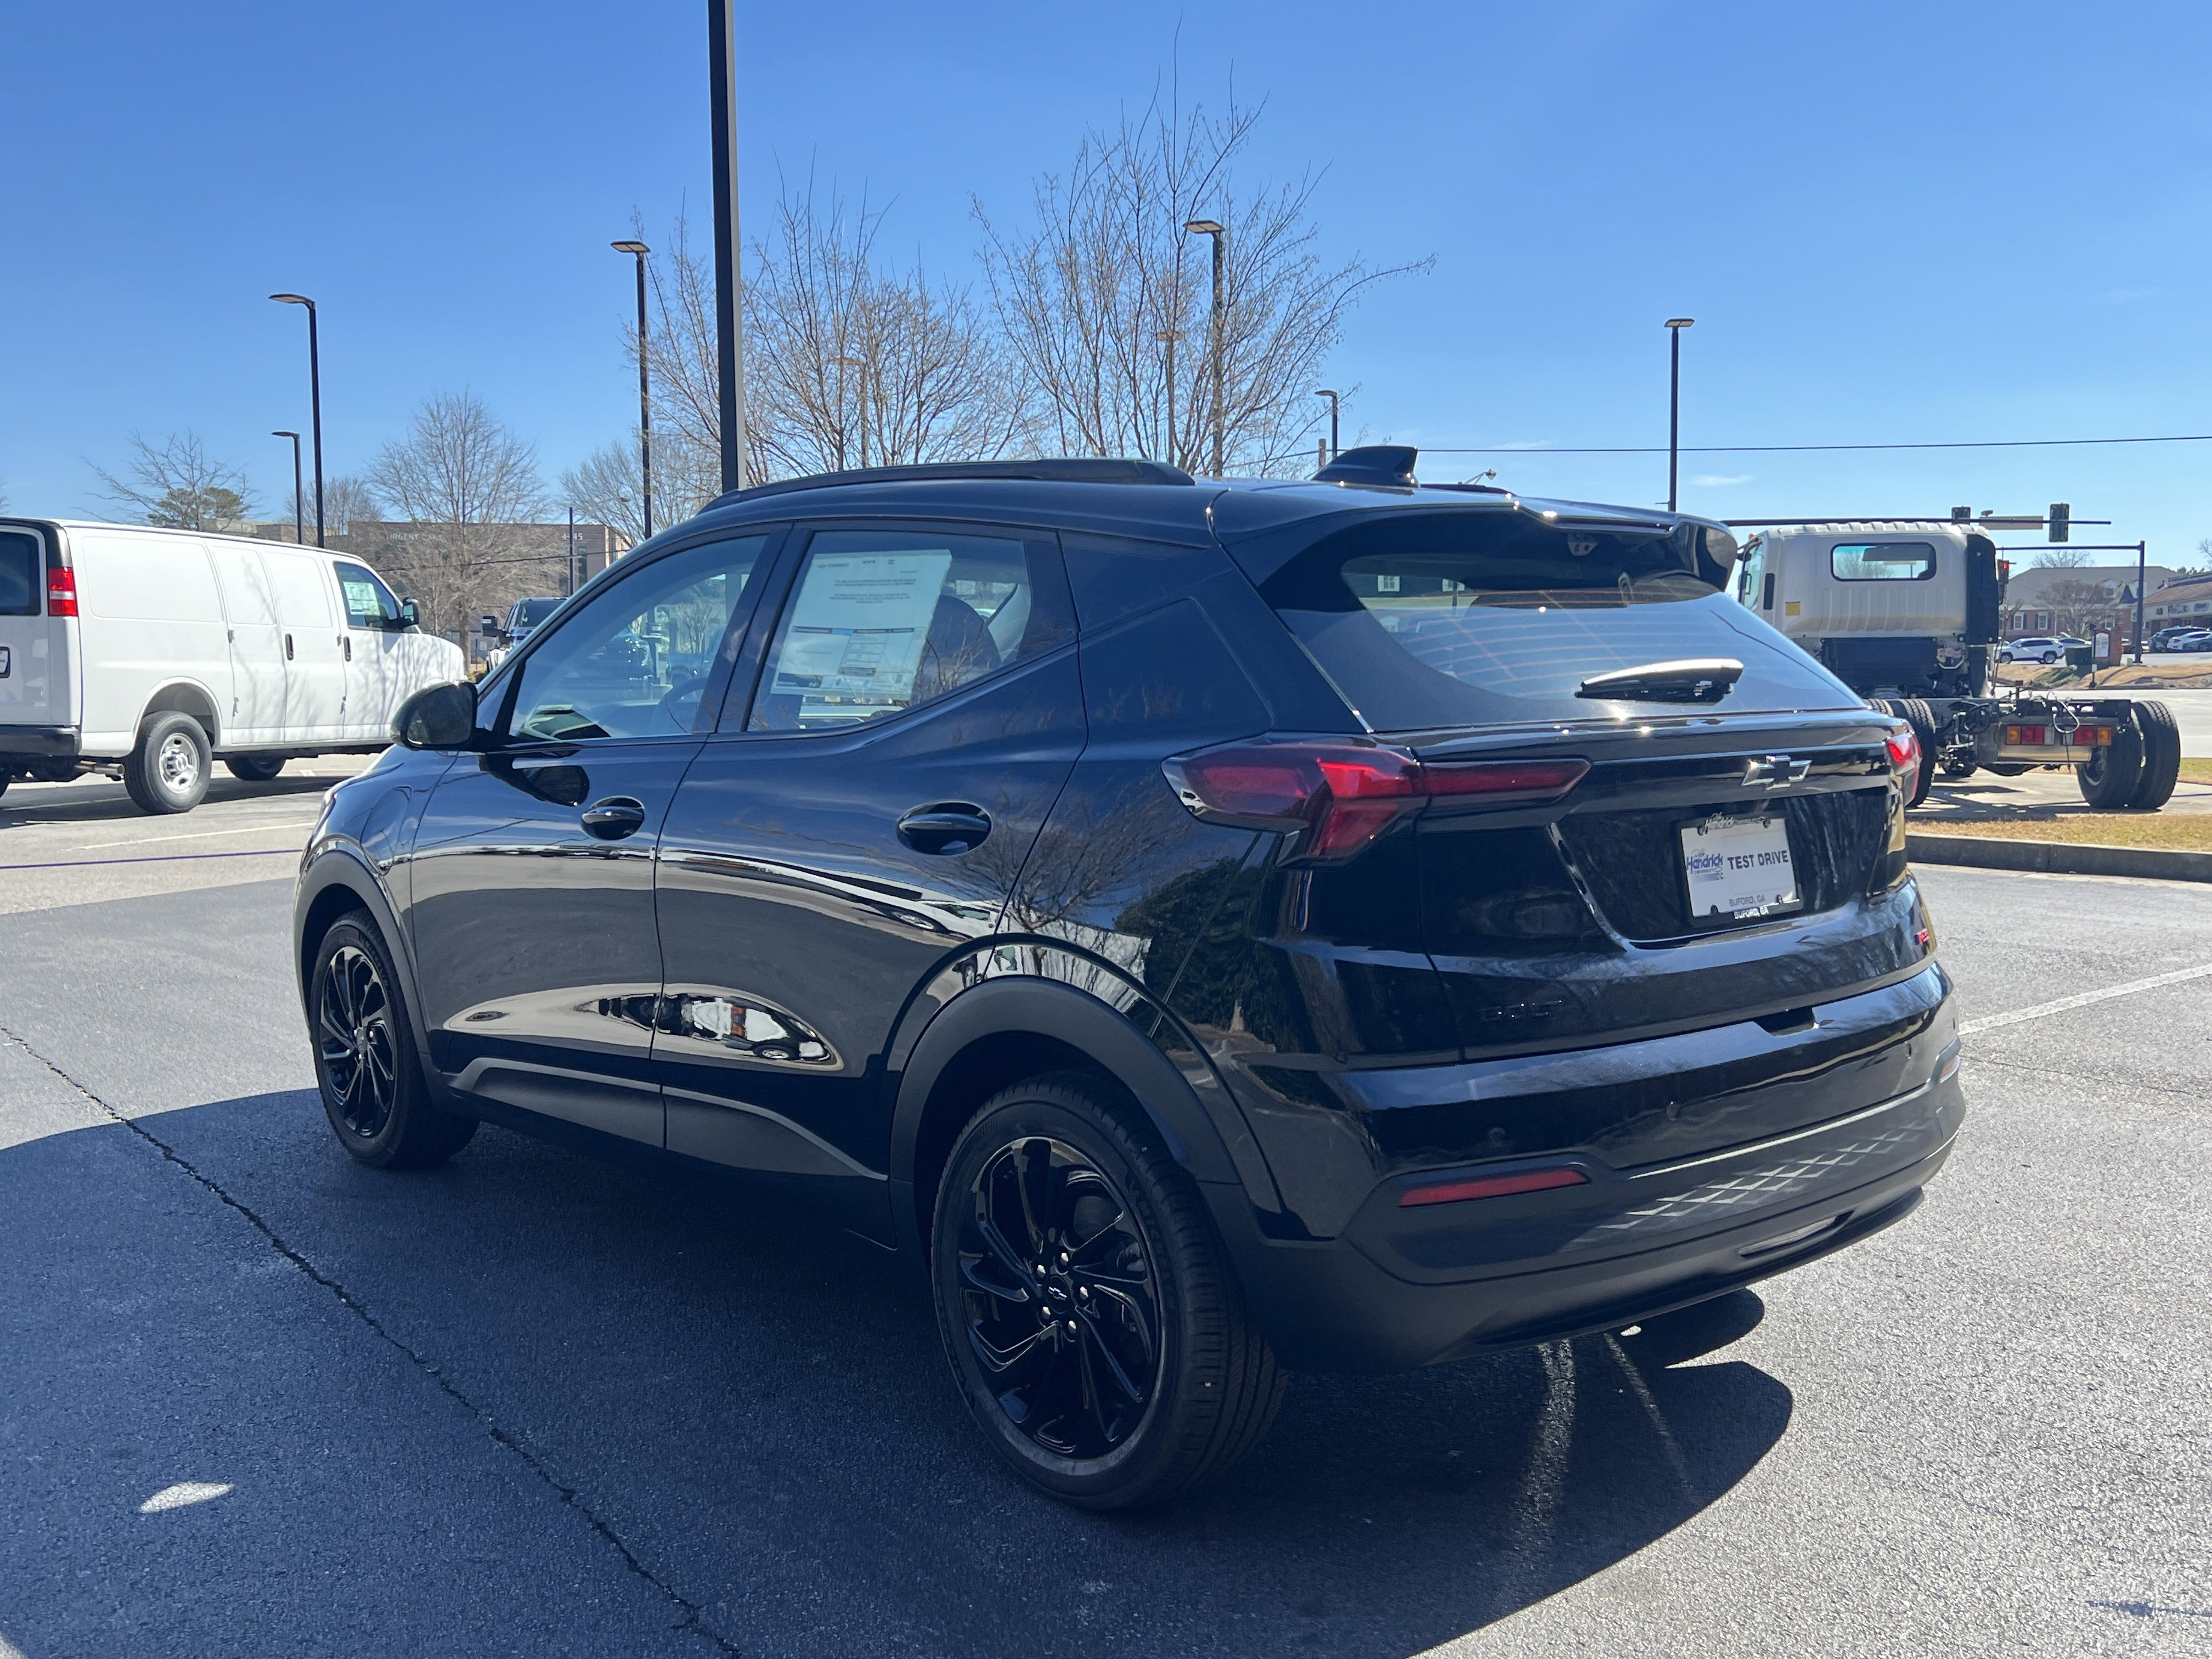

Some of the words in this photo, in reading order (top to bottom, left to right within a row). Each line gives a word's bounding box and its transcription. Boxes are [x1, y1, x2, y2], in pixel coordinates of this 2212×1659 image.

[1728, 855, 1754, 870] TEST
[1757, 850, 1789, 866] DRIVE
[1757, 895, 1765, 903] GA
